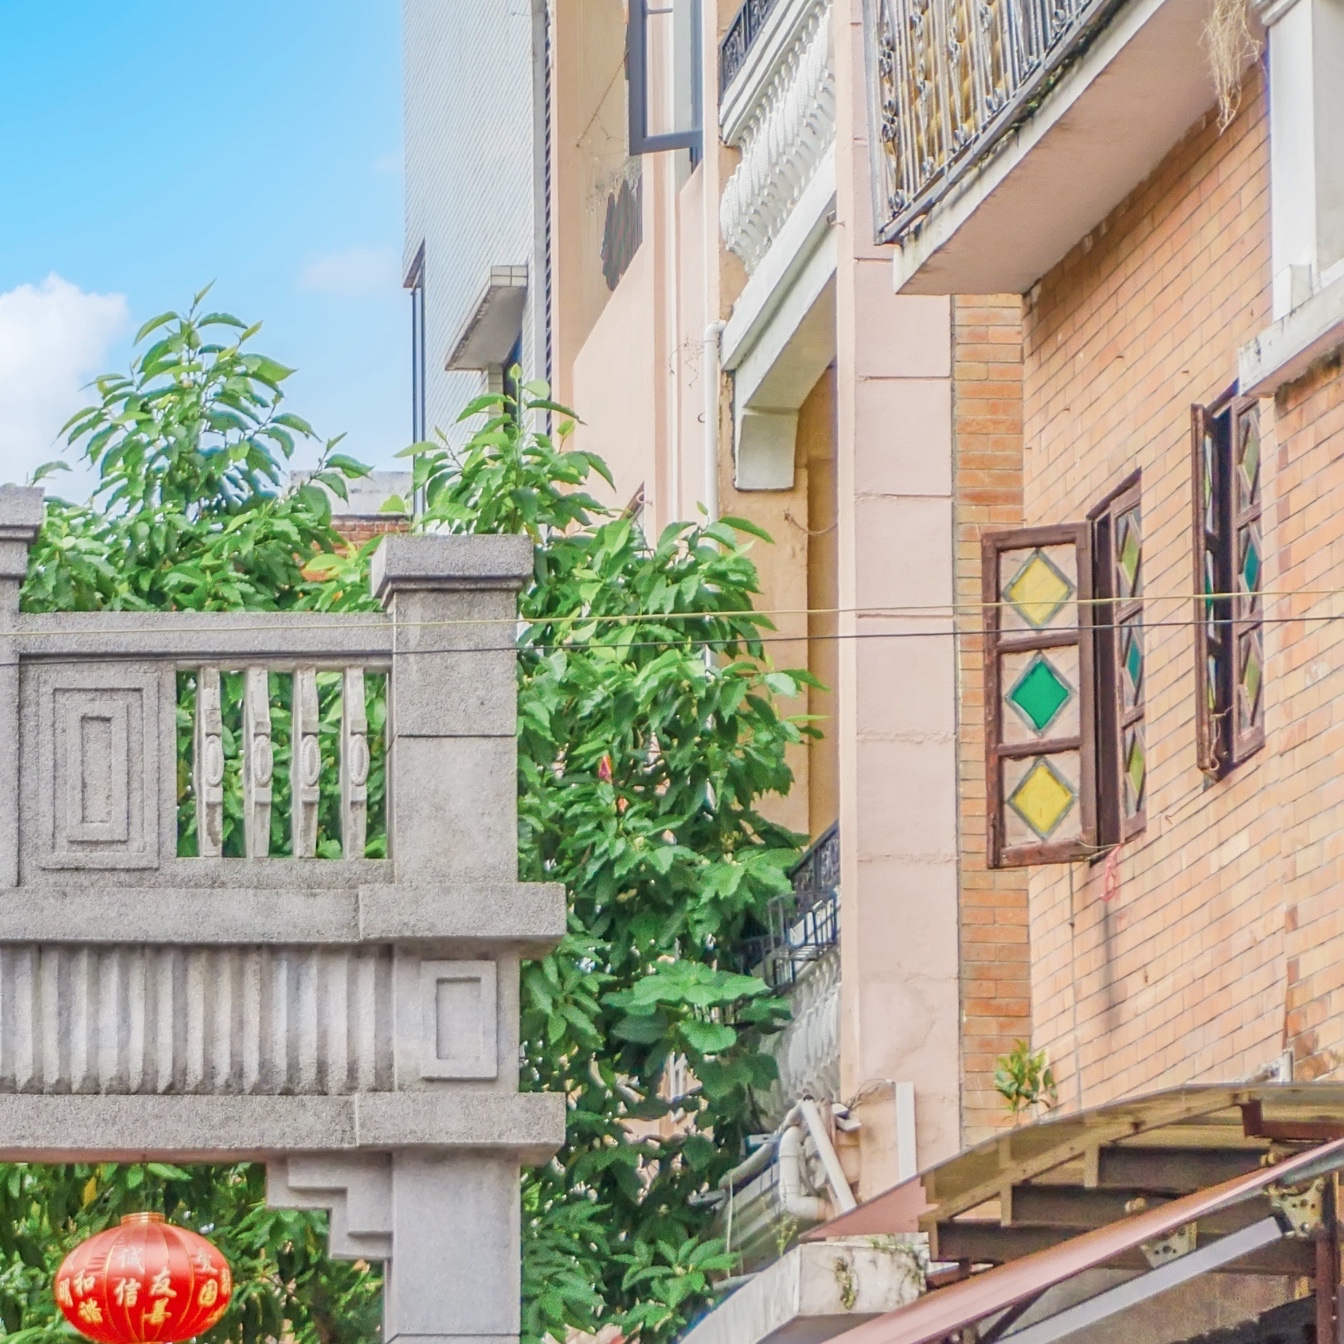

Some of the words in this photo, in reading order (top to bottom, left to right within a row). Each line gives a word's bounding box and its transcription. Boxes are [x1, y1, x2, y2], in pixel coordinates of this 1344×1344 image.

[73, 1269, 103, 1324] 和谐
[114, 1246, 145, 1307] 诚信
[144, 1266, 177, 1326] 友善
